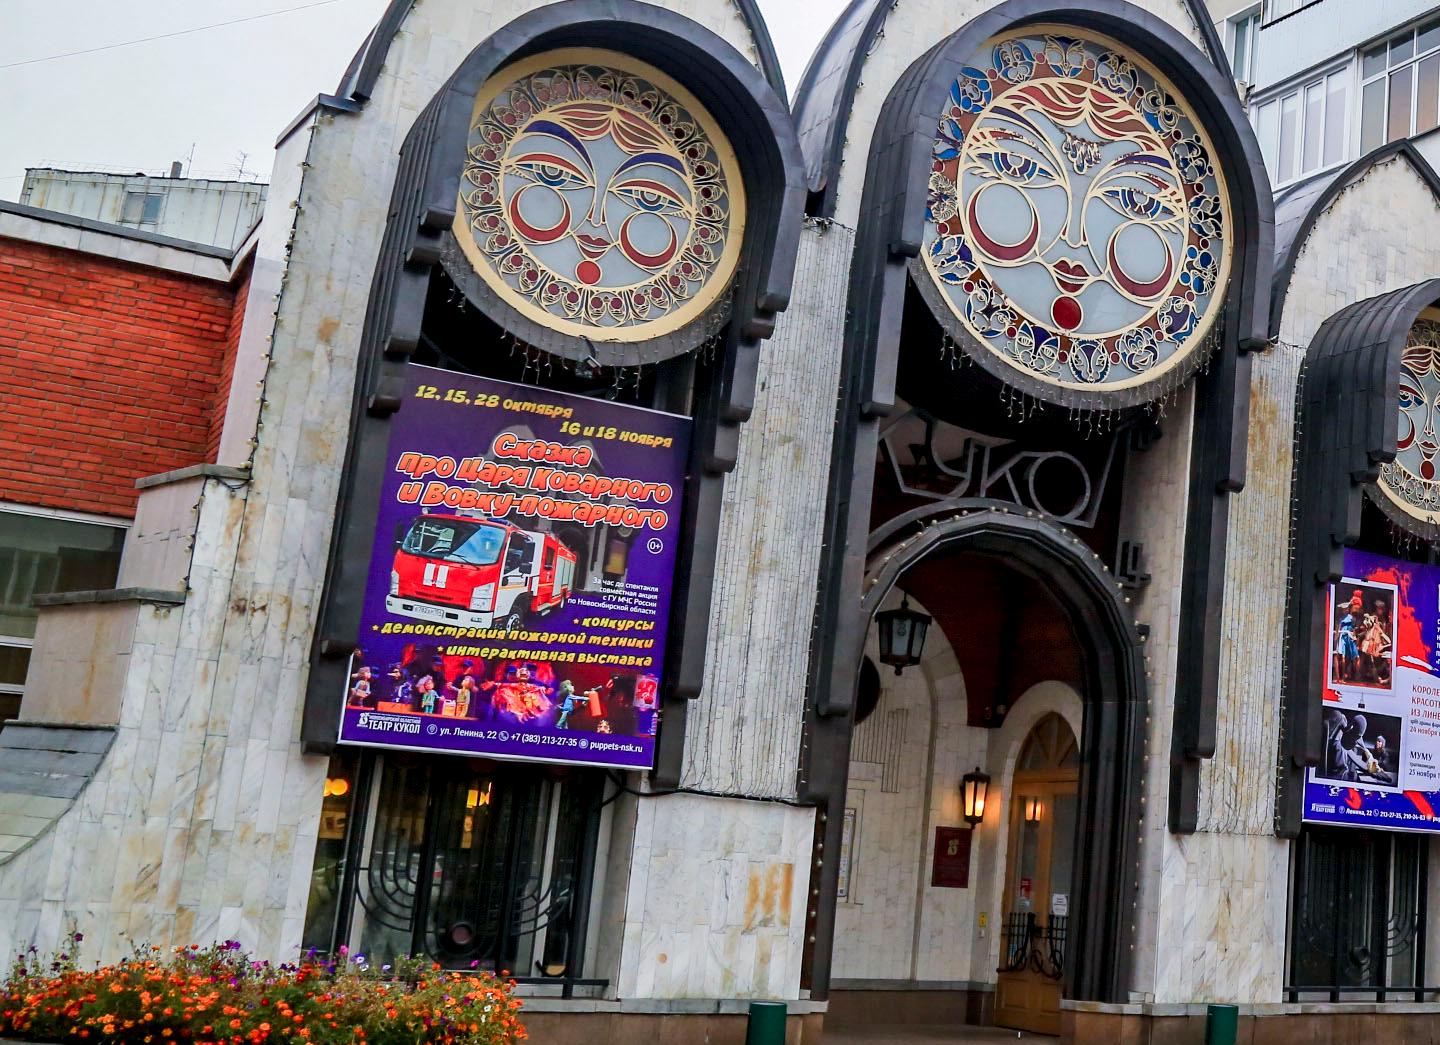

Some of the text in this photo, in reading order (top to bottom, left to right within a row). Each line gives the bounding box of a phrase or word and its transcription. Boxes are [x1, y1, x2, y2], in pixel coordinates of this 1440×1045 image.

[415, 385, 574, 419] 12, 15, 28 октября
[560, 421, 672, 448] 16 и 18 ноября
[494, 433, 592, 467] Сказка
[397, 452, 673, 503] про Царя Коварного
[397, 481, 669, 529] и Вовку-пожарного
[648, 541, 661, 550] 0+
[593, 577, 602, 585] За
[625, 582, 659, 593] спектакля
[599, 587, 658, 600] совместная акция
[577, 599, 629, 612] Новосибирской
[629, 605, 656, 615] области
[608, 595, 617, 603] ГУ
[617, 596, 633, 604] МЧС
[634, 599, 657, 608] России
[582, 616, 655, 632] конкурсы
[381, 622, 654, 649] демонстрация пожарной техники
[446, 645, 653, 667] интерактивная выставка
[1411, 708, 1421, 717] ИЗ
[369, 720, 420, 734] ТЕАТР КУКОЛ
[440, 728, 497, 739] ул. Ленина, 22
[1417, 727, 1437, 737] ноября
[511, 733, 577, 747] +7 (383) 213-27-35
[590, 741, 643, 753] puppets-nsk.ru
[1410, 750, 1432, 761] МУМУ
[1416, 771, 1437, 780] ноября
